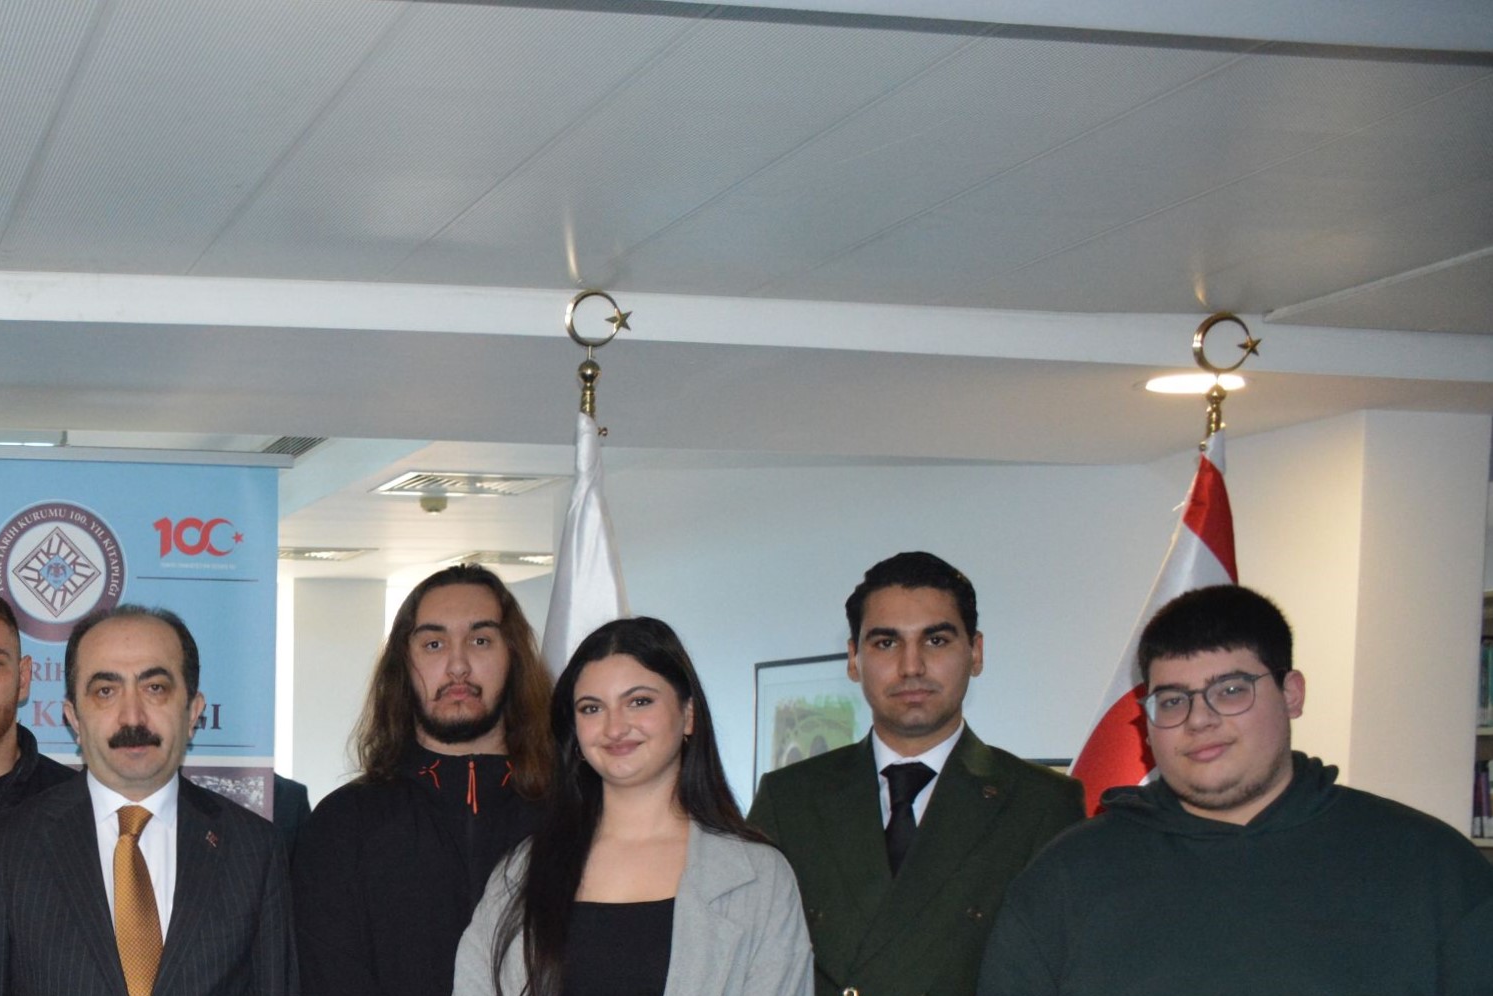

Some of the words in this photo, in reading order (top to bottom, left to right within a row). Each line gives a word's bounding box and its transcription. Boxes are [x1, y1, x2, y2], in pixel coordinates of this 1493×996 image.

[18, 508, 68, 529] KURUMU
[69, 511, 88, 526] 100.
[90, 521, 106, 540] YIL
[102, 538, 121, 598] KİTAPLIĞI
